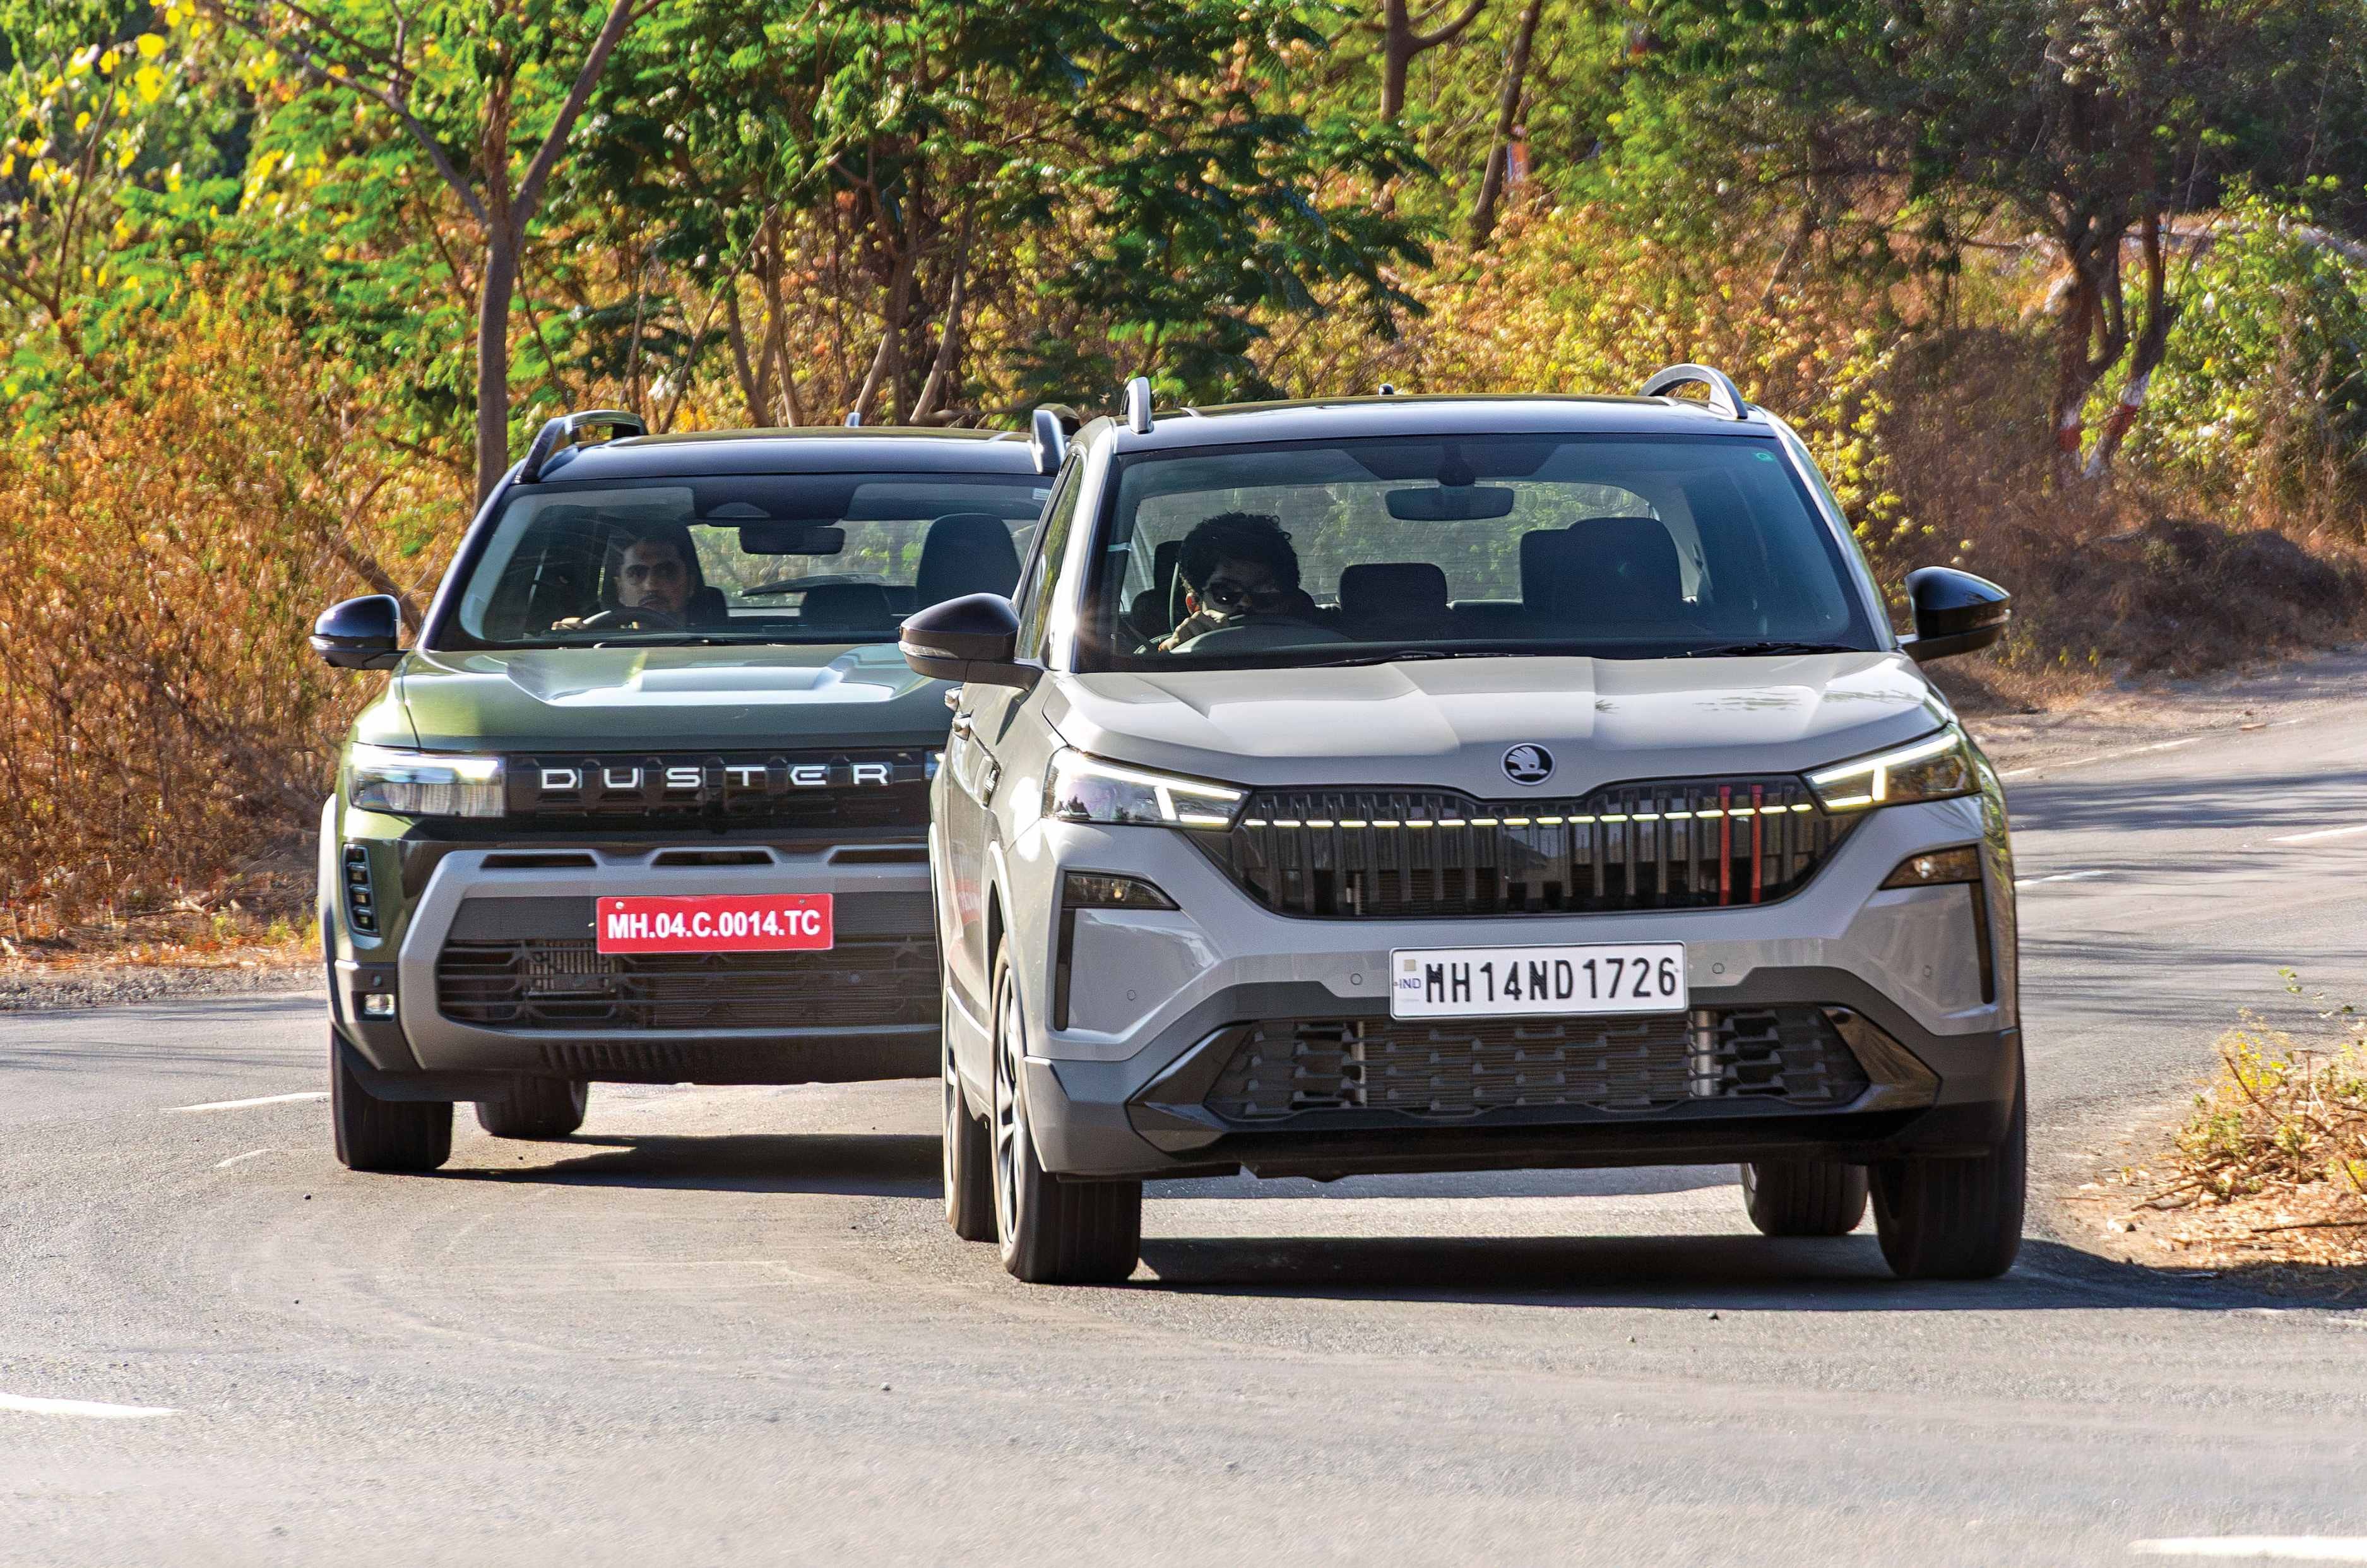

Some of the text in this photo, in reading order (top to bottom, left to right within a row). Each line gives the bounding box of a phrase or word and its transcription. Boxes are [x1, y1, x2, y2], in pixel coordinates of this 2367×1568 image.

[541, 764, 889, 789] DUSTER
[607, 910, 821, 939] MH.04.C.0014.TC
[1399, 978, 1421, 989] IND
[1425, 957, 1676, 1003] MH14ND1726
